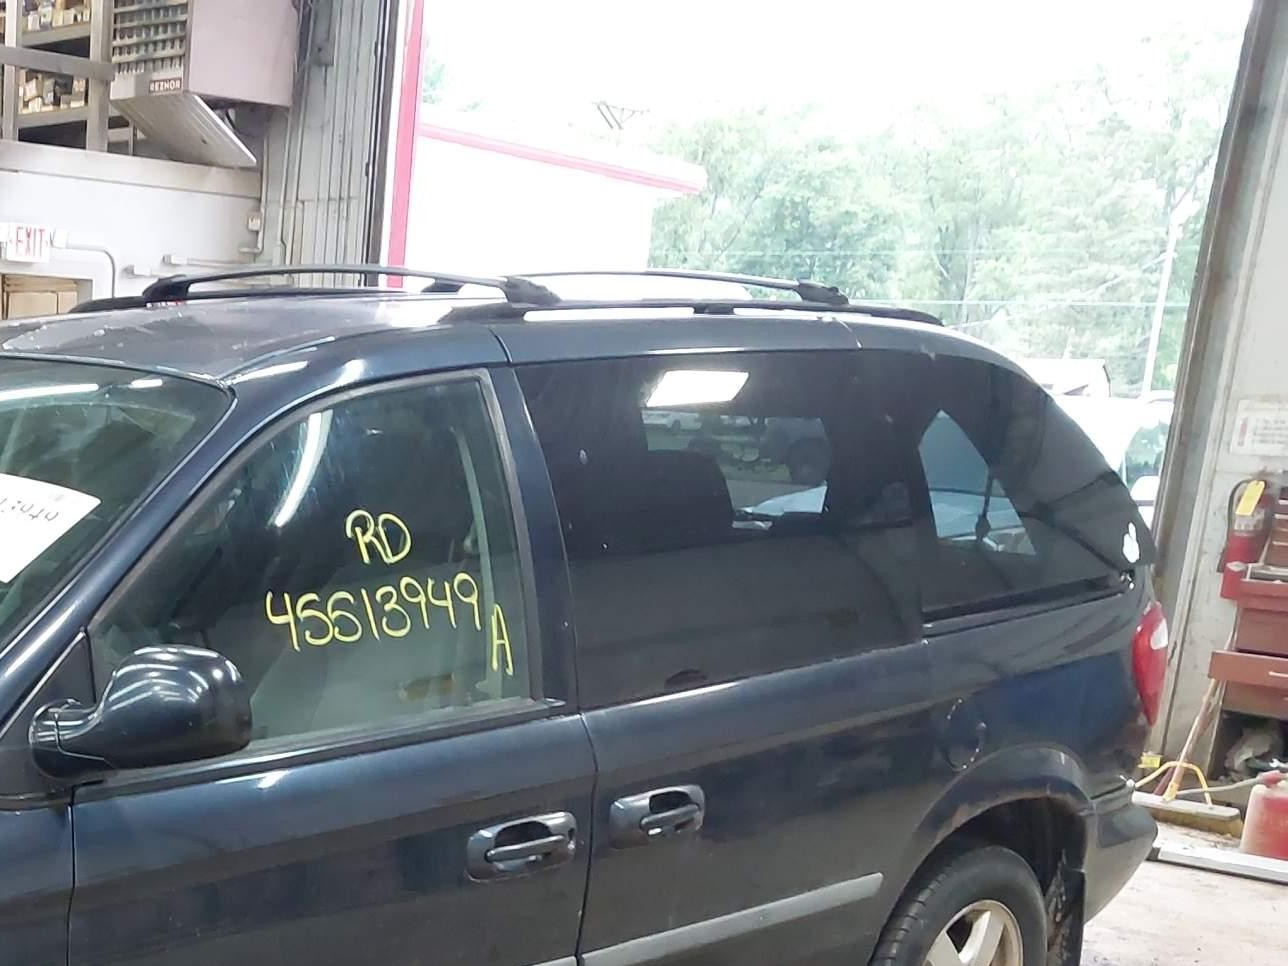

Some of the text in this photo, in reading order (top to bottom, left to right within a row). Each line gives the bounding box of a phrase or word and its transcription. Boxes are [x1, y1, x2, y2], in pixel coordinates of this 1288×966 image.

[149, 79, 181, 92] REZNOR
[15, 226, 46, 257] EXIT
[345, 508, 412, 565] RD
[265, 571, 514, 676] 45513949 A
